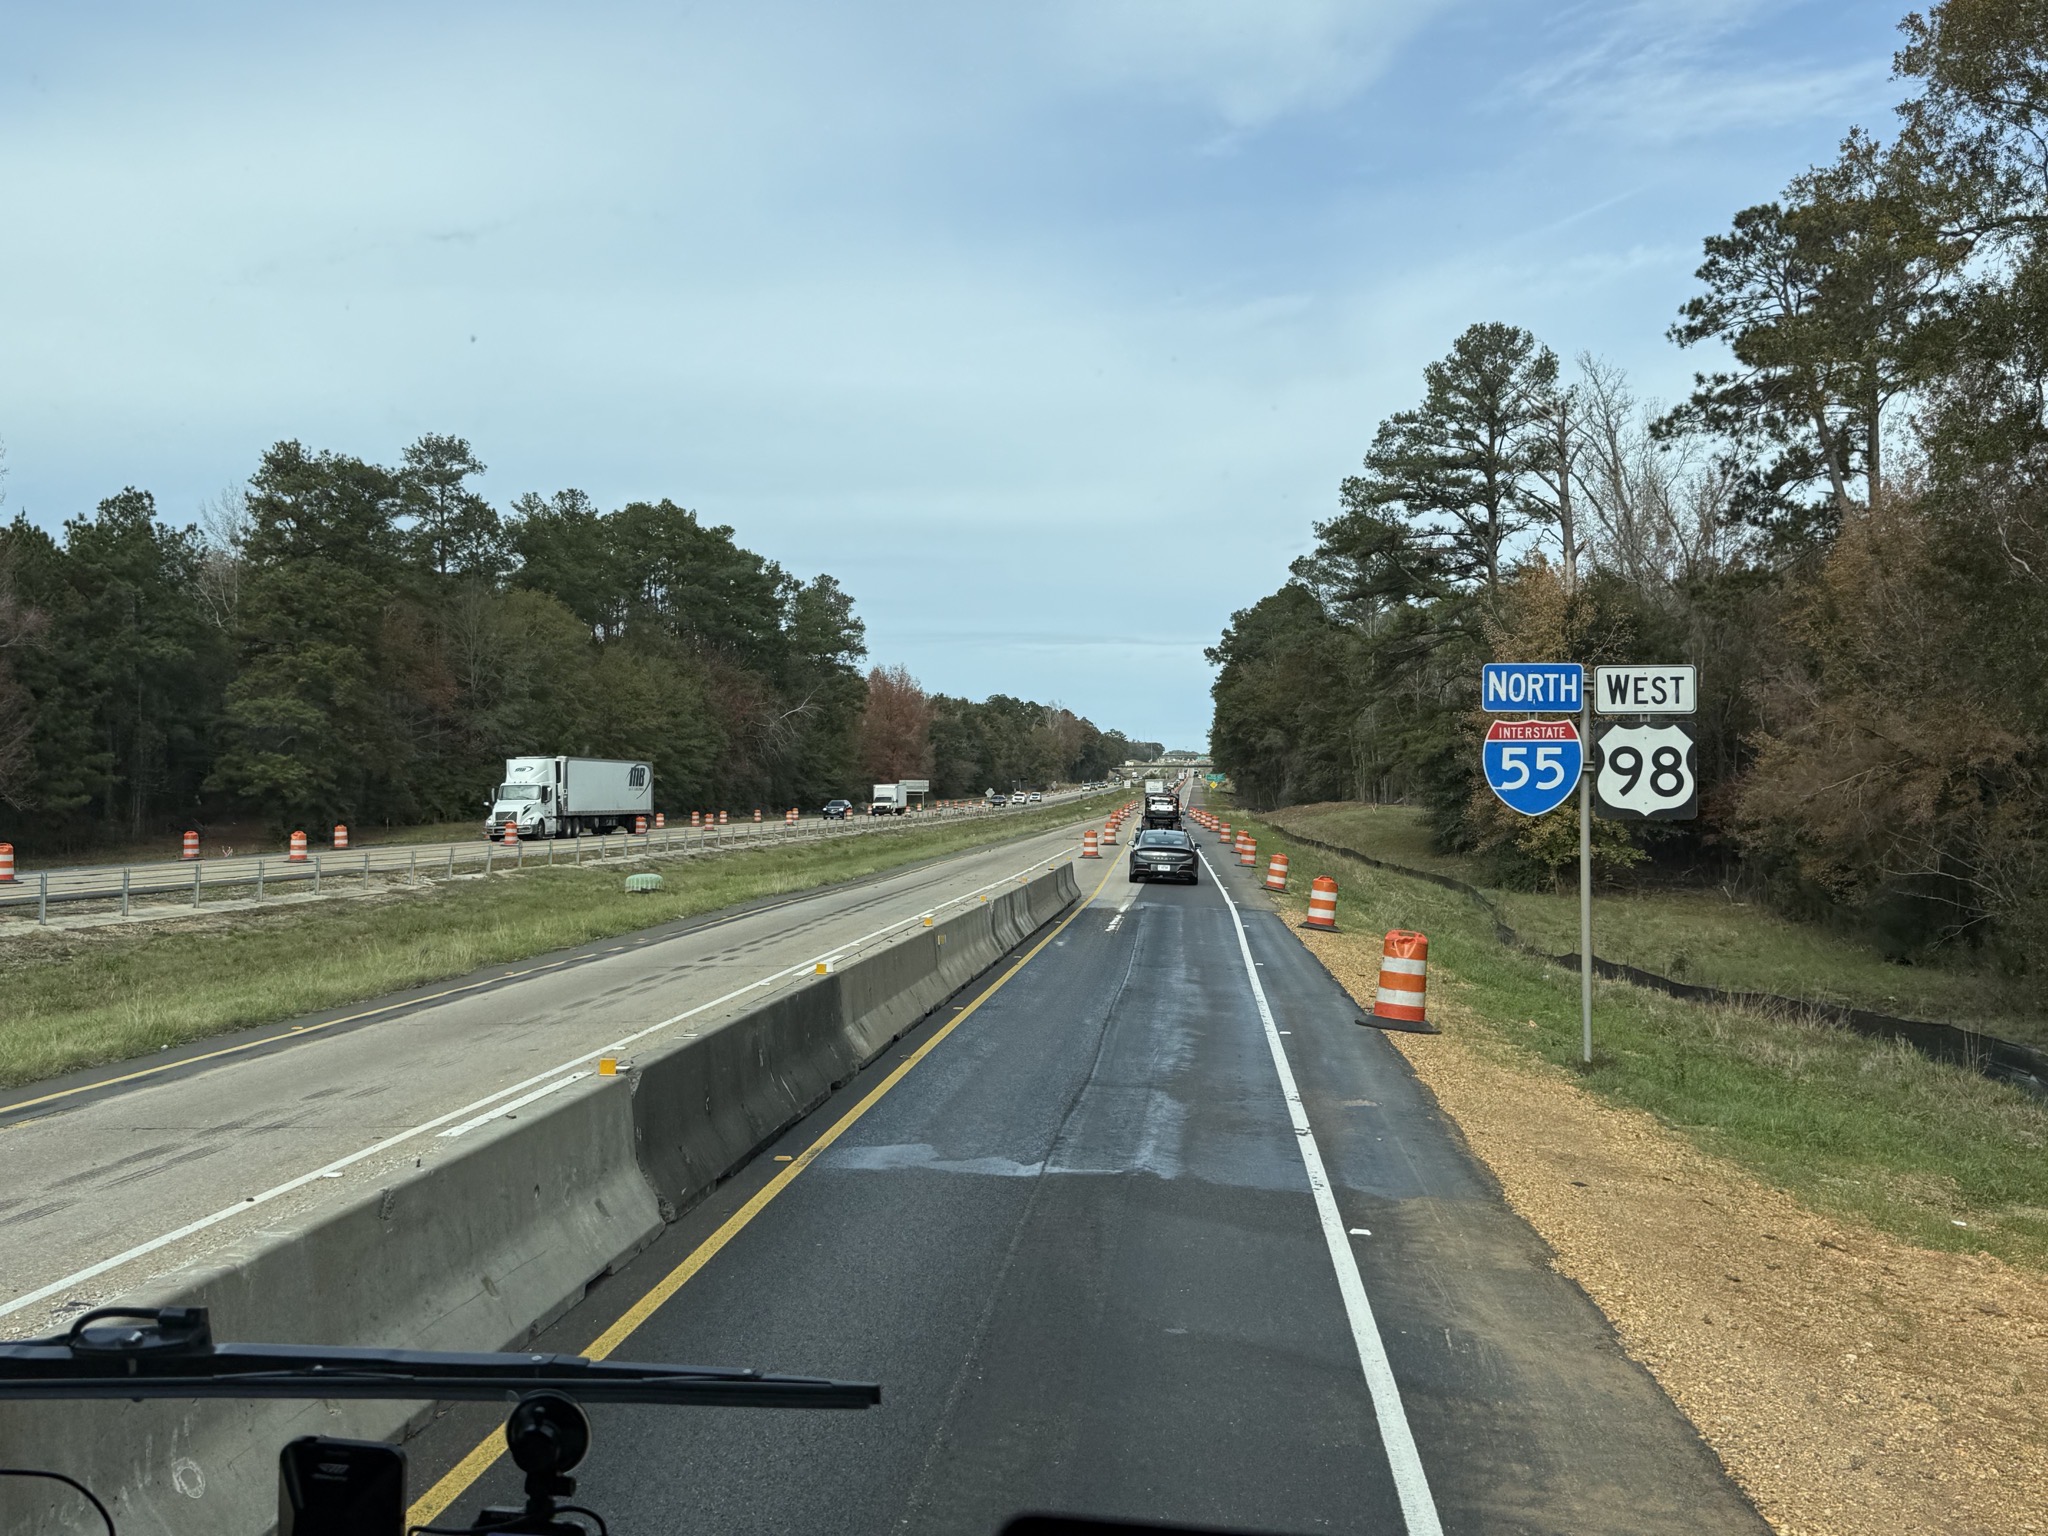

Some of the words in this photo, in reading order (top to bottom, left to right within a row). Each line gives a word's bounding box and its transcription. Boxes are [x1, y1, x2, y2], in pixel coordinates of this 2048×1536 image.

[1488, 671, 1577, 702] NORTH
[1606, 674, 1685, 705] WEST
[1499, 727, 1566, 739] INTERSTATE
[1501, 747, 1565, 790] 55
[1609, 746, 1685, 798] 98
